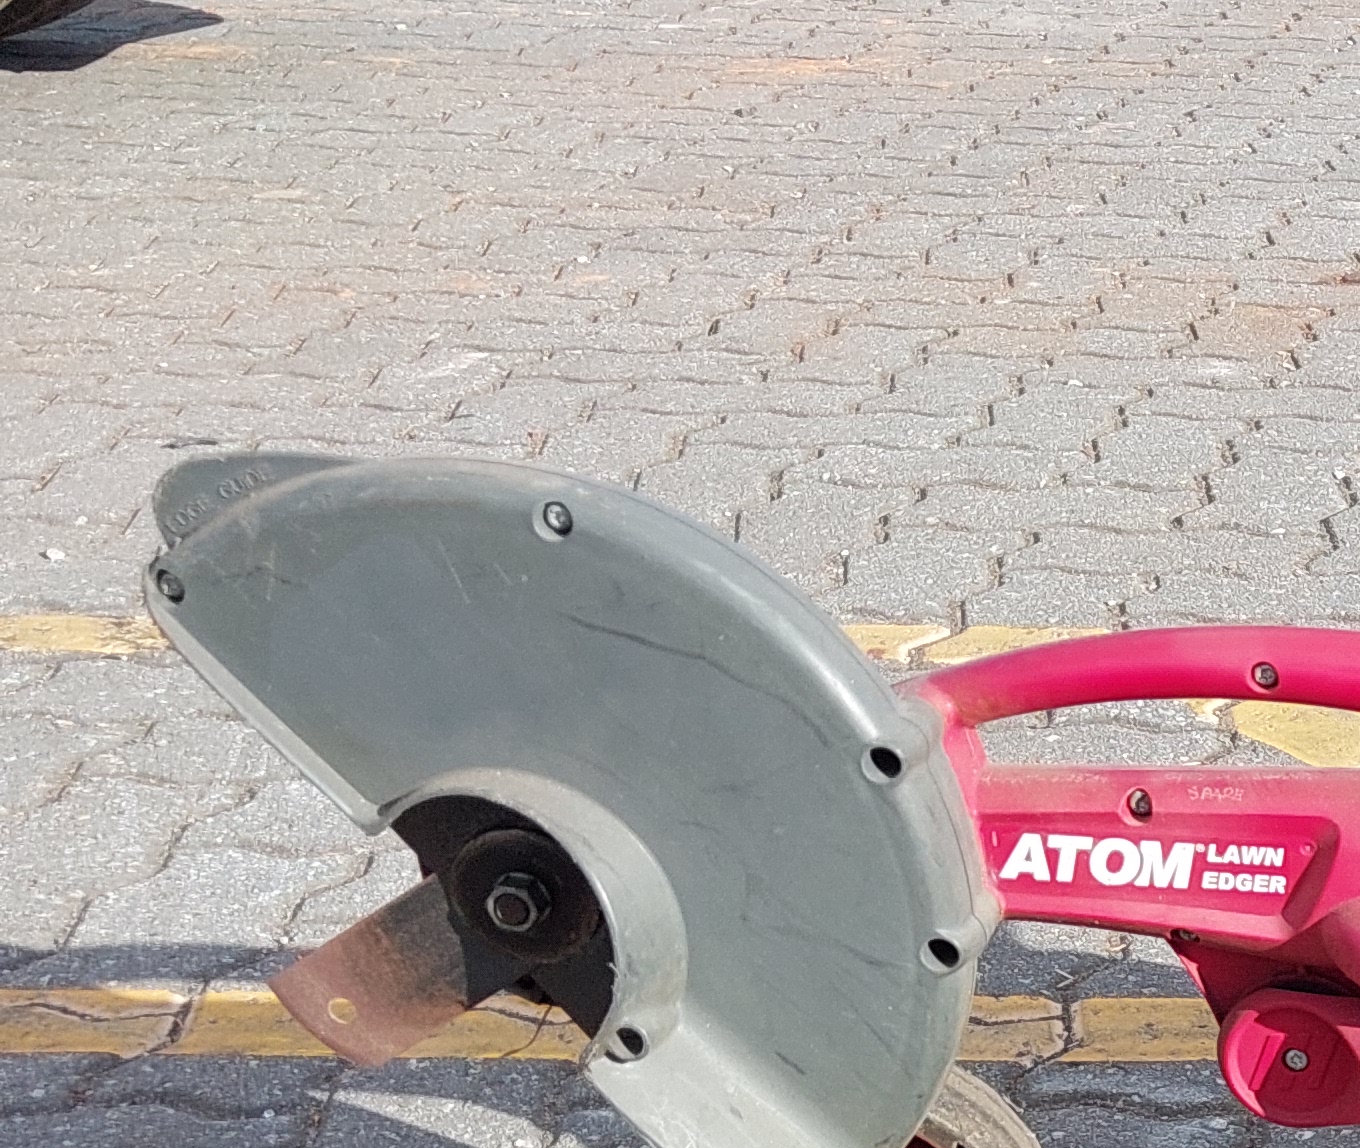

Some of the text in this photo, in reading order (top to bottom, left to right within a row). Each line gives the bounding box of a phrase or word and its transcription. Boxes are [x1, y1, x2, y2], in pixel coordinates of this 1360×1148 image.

[999, 832, 1285, 889] ATOM LAWN
[1201, 871, 1287, 894] EDGER
